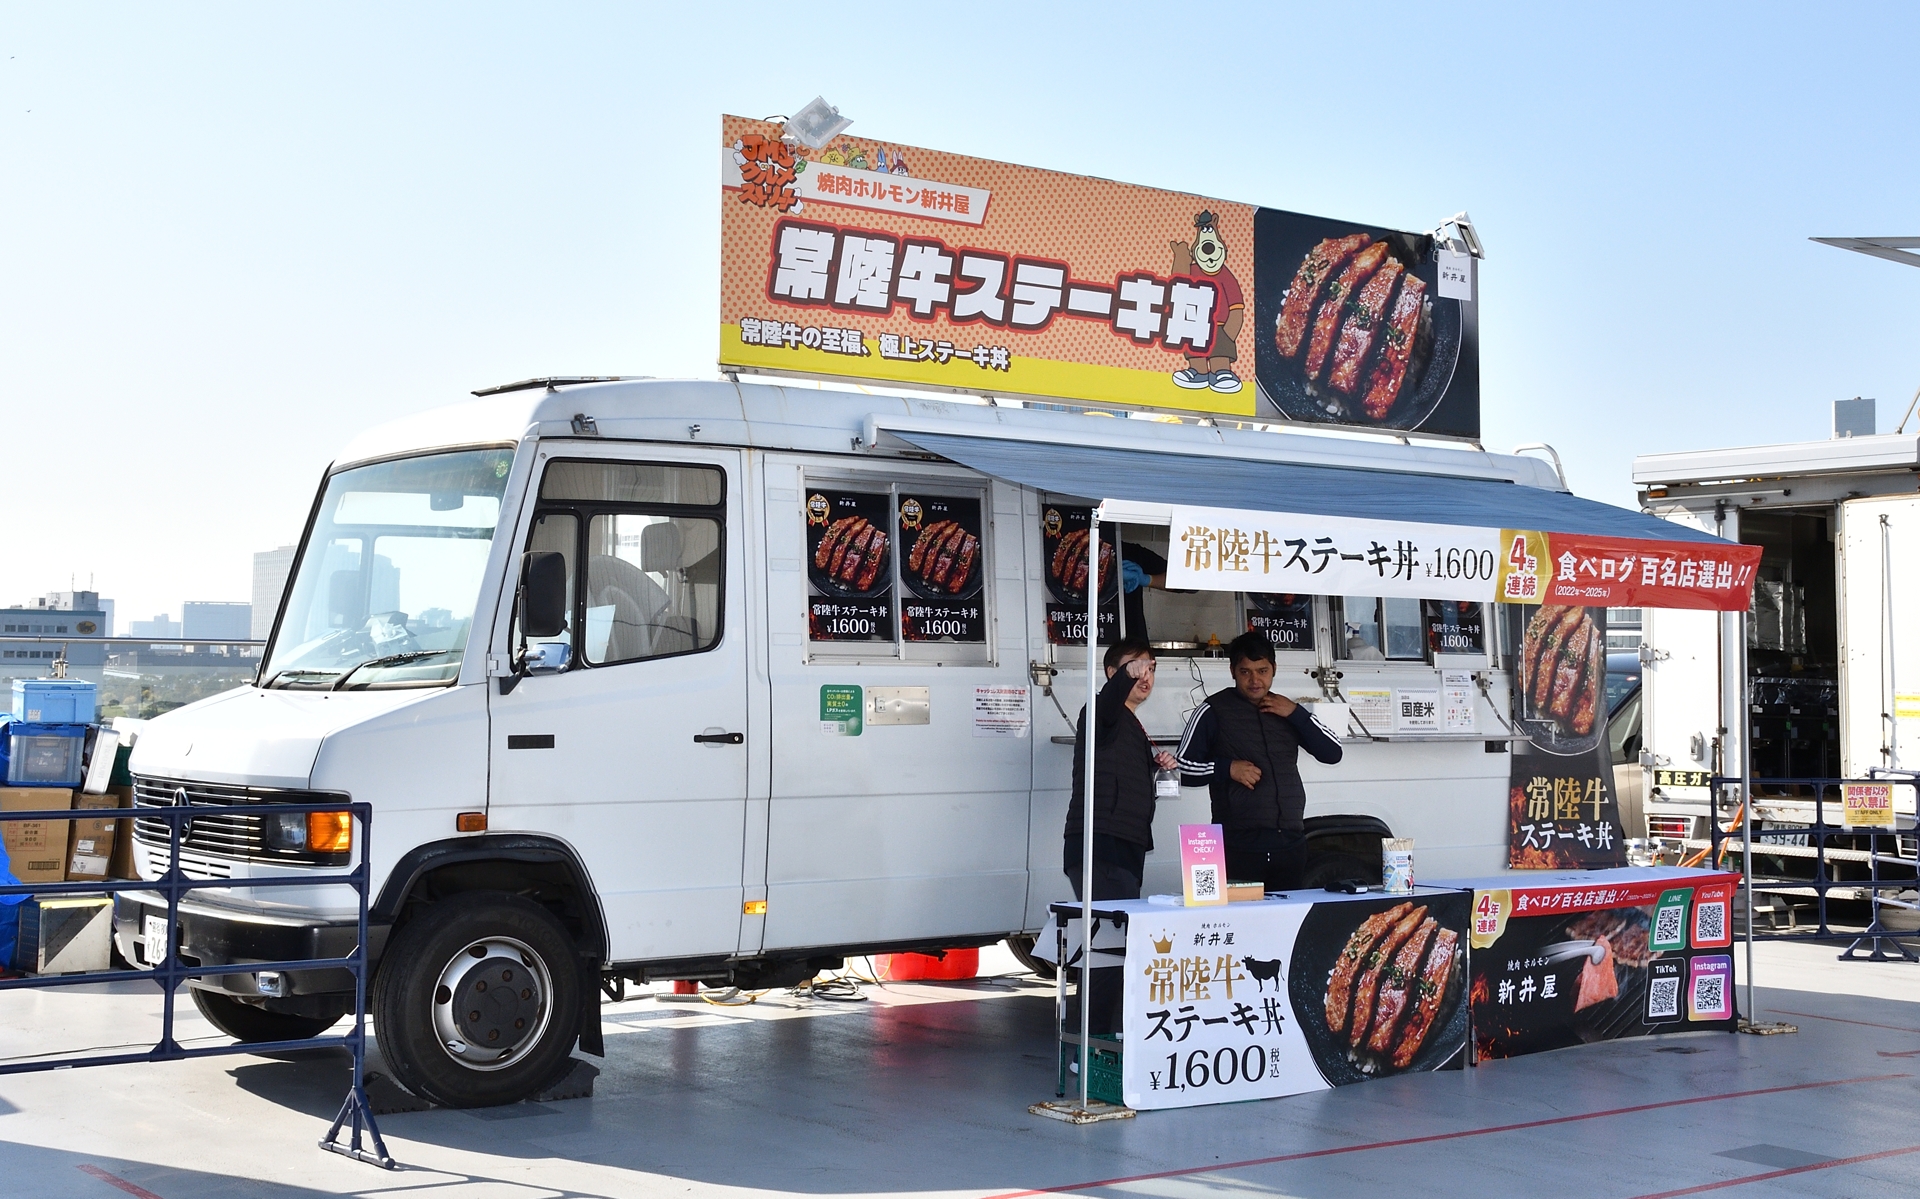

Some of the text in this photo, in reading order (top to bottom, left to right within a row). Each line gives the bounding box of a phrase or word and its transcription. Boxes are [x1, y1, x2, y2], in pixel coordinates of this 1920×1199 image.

[740, 160, 797, 186] グルメ
[817, 171, 970, 214] 焼肉ホルモン新井屋
[774, 225, 1215, 346] 常陸牛ステーキ丼
[740, 319, 1010, 370] 常陸牛の至福、極上ステーキ丼
[1180, 525, 1494, 581] 常陸牛ステーキ丼 ¥1,600
[1510, 537, 1536, 571] 4年
[1506, 575, 1536, 596] 連続
[812, 604, 888, 617] 常陸牛ステーキ丼
[906, 606, 978, 619] 常陸牛ステーキ丼
[1050, 611, 1115, 623] 常陸牛ステキ丼
[1251, 616, 1308, 629] 常陸牛ステーキ丼
[1431, 622, 1480, 634] 常陸牛ステーキ丼
[1401, 701, 1435, 718] 国産米
[1526, 776, 1609, 821] 常陸牛
[1847, 786, 1889, 796] 関係者以外
[1847, 797, 1889, 809] 立入禁止
[1520, 821, 1613, 850] ステーキ丼
[1668, 894, 1682, 903] LINE
[1701, 891, 1724, 899] YouTube
[1477, 894, 1499, 916] 4年
[1476, 919, 1497, 933] 連続
[1193, 932, 1235, 947] 新井屋
[1507, 956, 1550, 971] 焼肉 ホルモン
[1655, 964, 1677, 974] TikTok
[1694, 962, 1727, 972] Instagram
[1144, 953, 1246, 1005] 常陸牛
[1498, 974, 1558, 1005] 新井屋
[1144, 997, 1285, 1043] ステーキ丼
[1149, 1044, 1280, 1093] ¥1,600 税込
